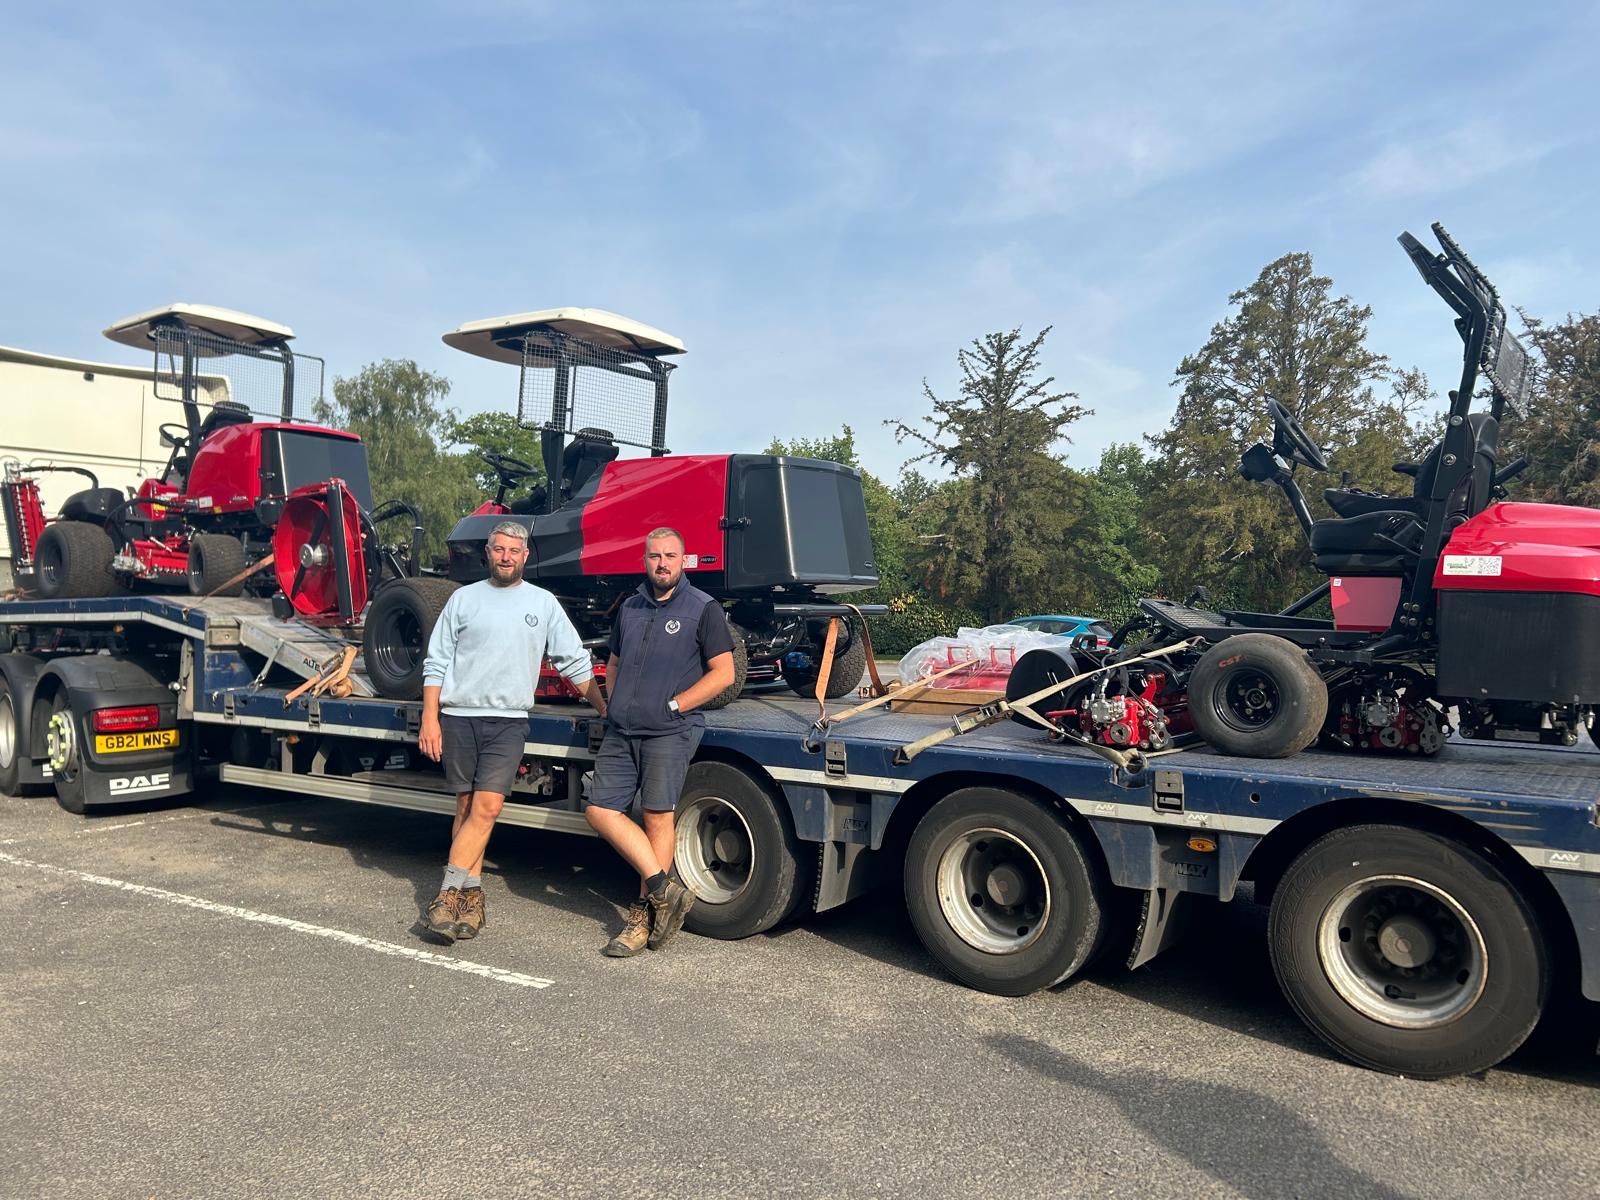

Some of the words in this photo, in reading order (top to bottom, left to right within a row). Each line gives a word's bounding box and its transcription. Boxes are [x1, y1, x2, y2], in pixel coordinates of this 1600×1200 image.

[105, 735, 139, 749] GB21
[143, 733, 171, 747] WNS
[109, 773, 170, 790] DAF
